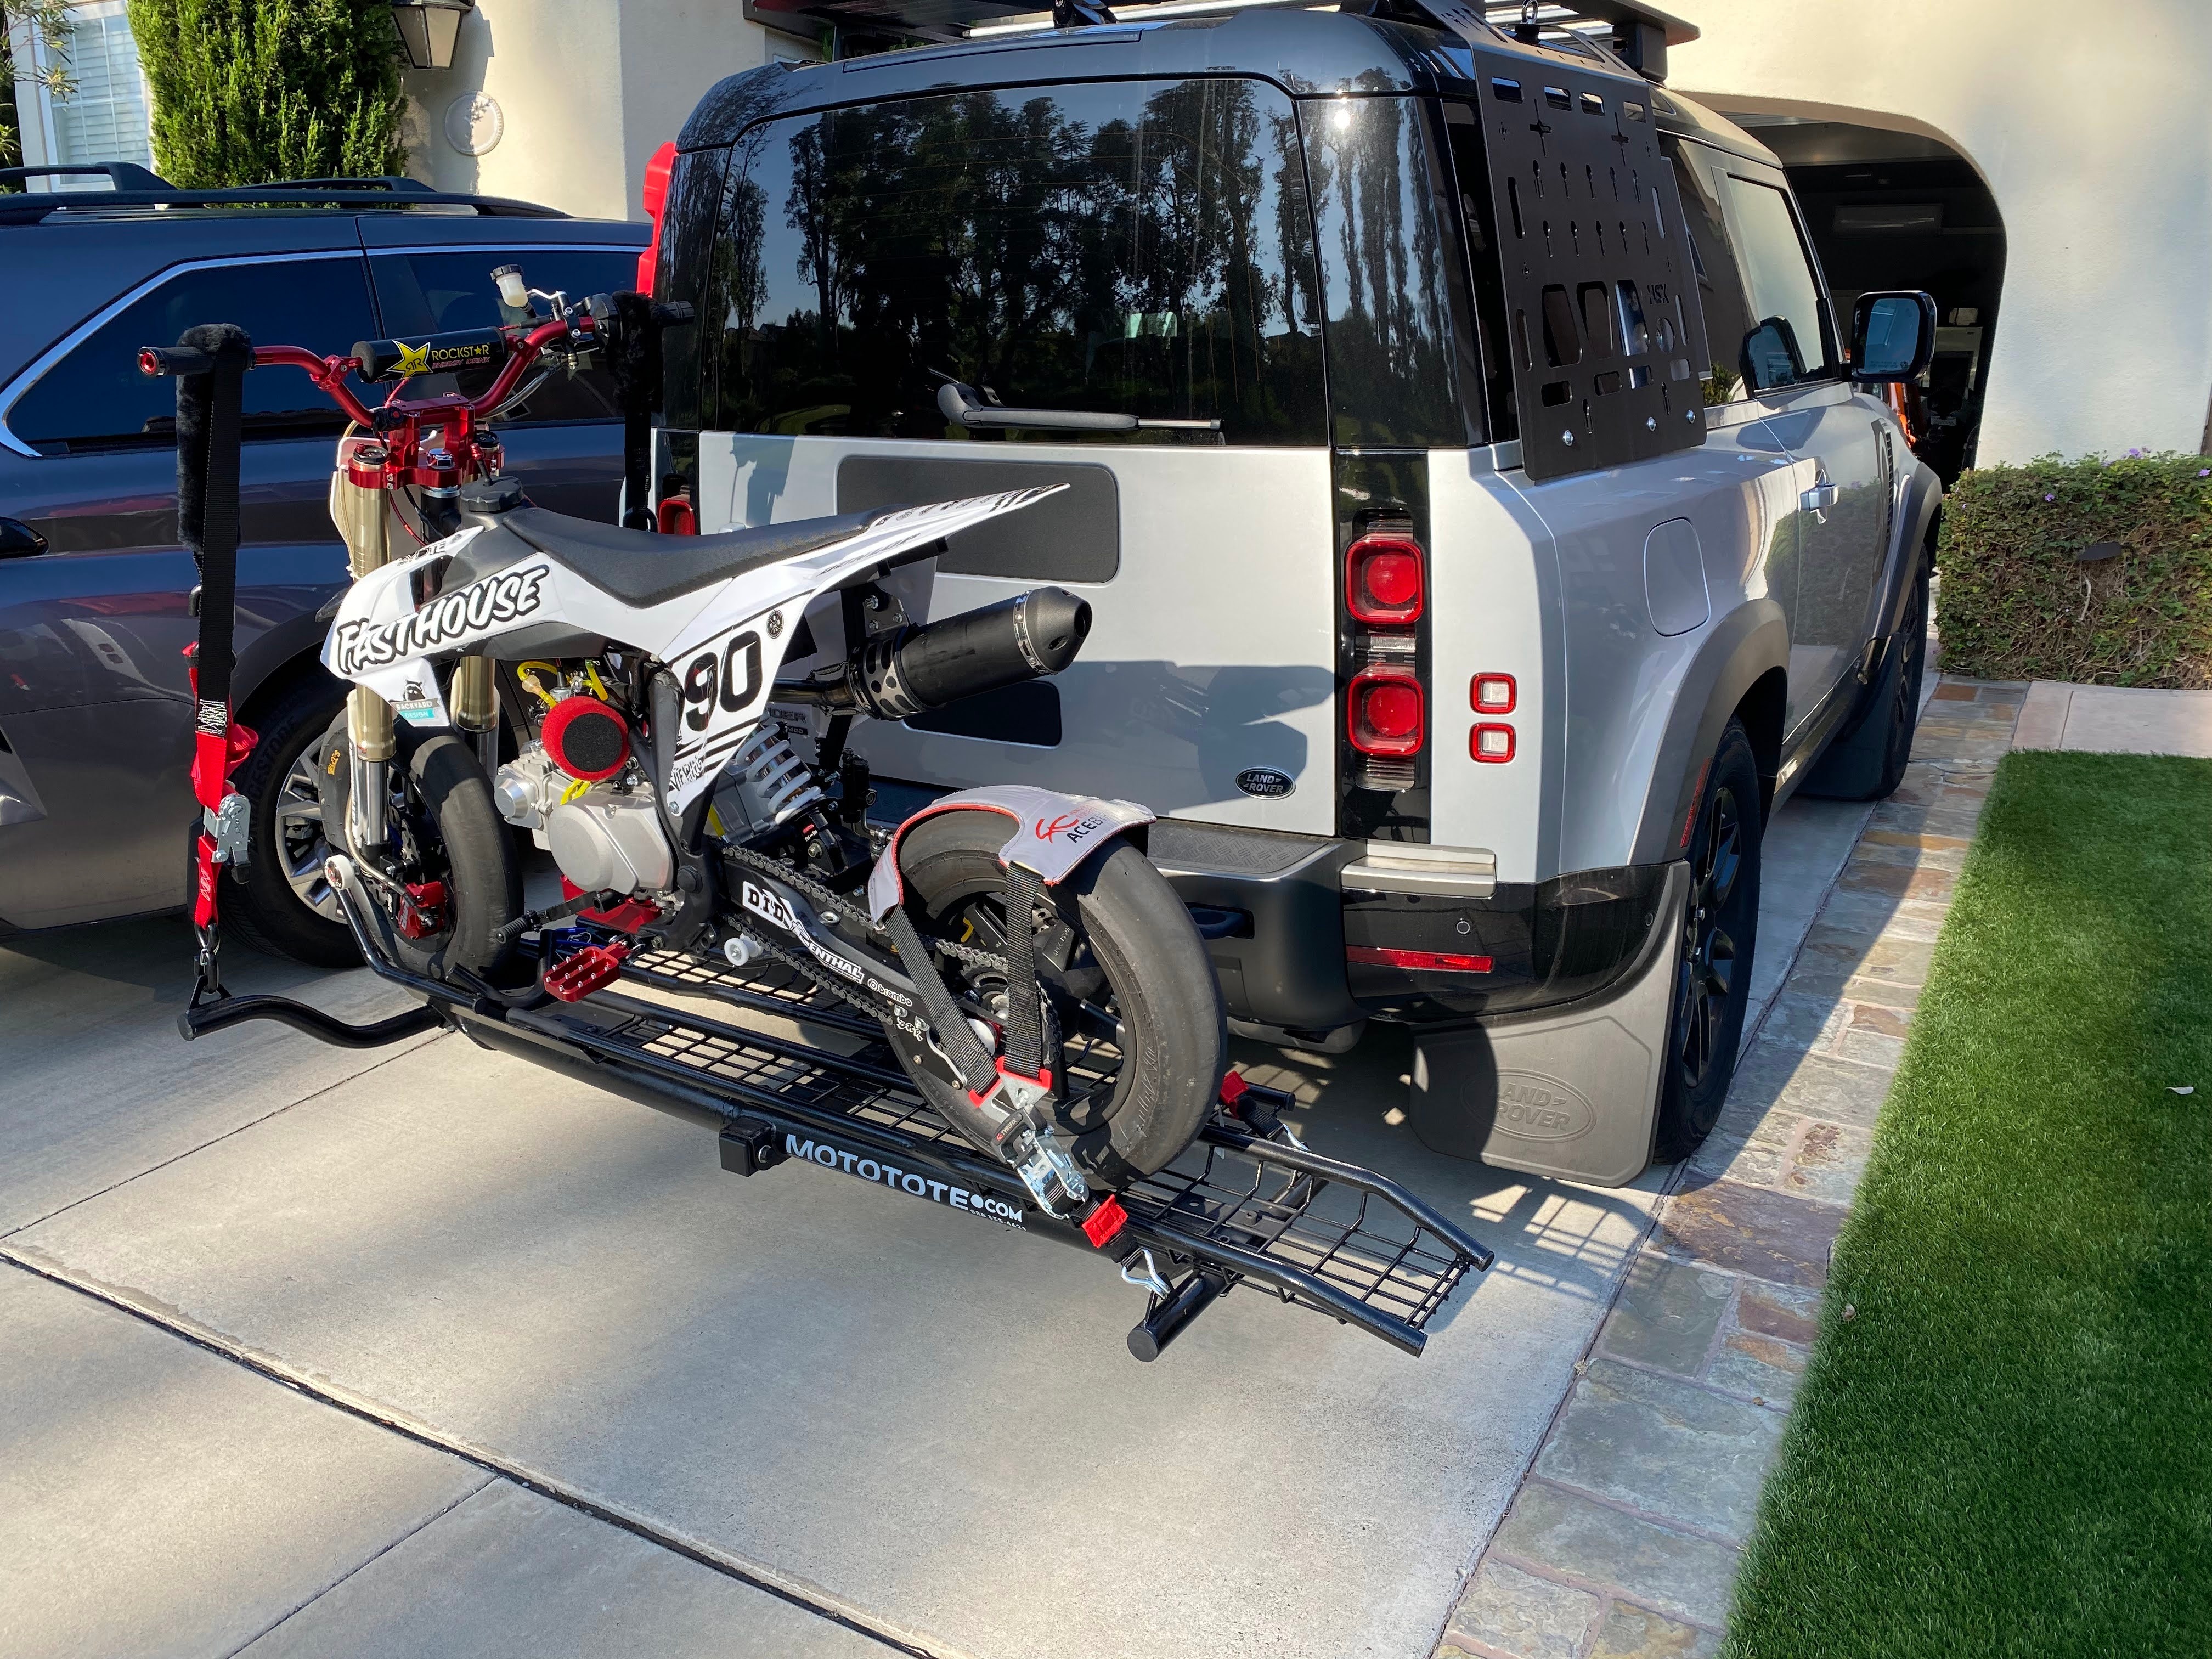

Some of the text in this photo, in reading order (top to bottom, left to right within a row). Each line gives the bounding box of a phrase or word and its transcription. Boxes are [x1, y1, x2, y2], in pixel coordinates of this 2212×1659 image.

[432, 356, 491, 369] ENERGY DRINK
[337, 564, 549, 675] FASTHOUSE
[684, 630, 763, 731] 90
[396, 701, 433, 710] BACKYARD
[405, 710, 429, 719] DESIGN
[1246, 774, 1275, 784] LAND
[1249, 783, 1284, 793] ROVER
[878, 984, 912, 1007] brembo
[1498, 1082, 1552, 1107] AND
[1497, 1099, 1571, 1131] ROVER
[1001, 1118, 1018, 1135] TYREFIX
